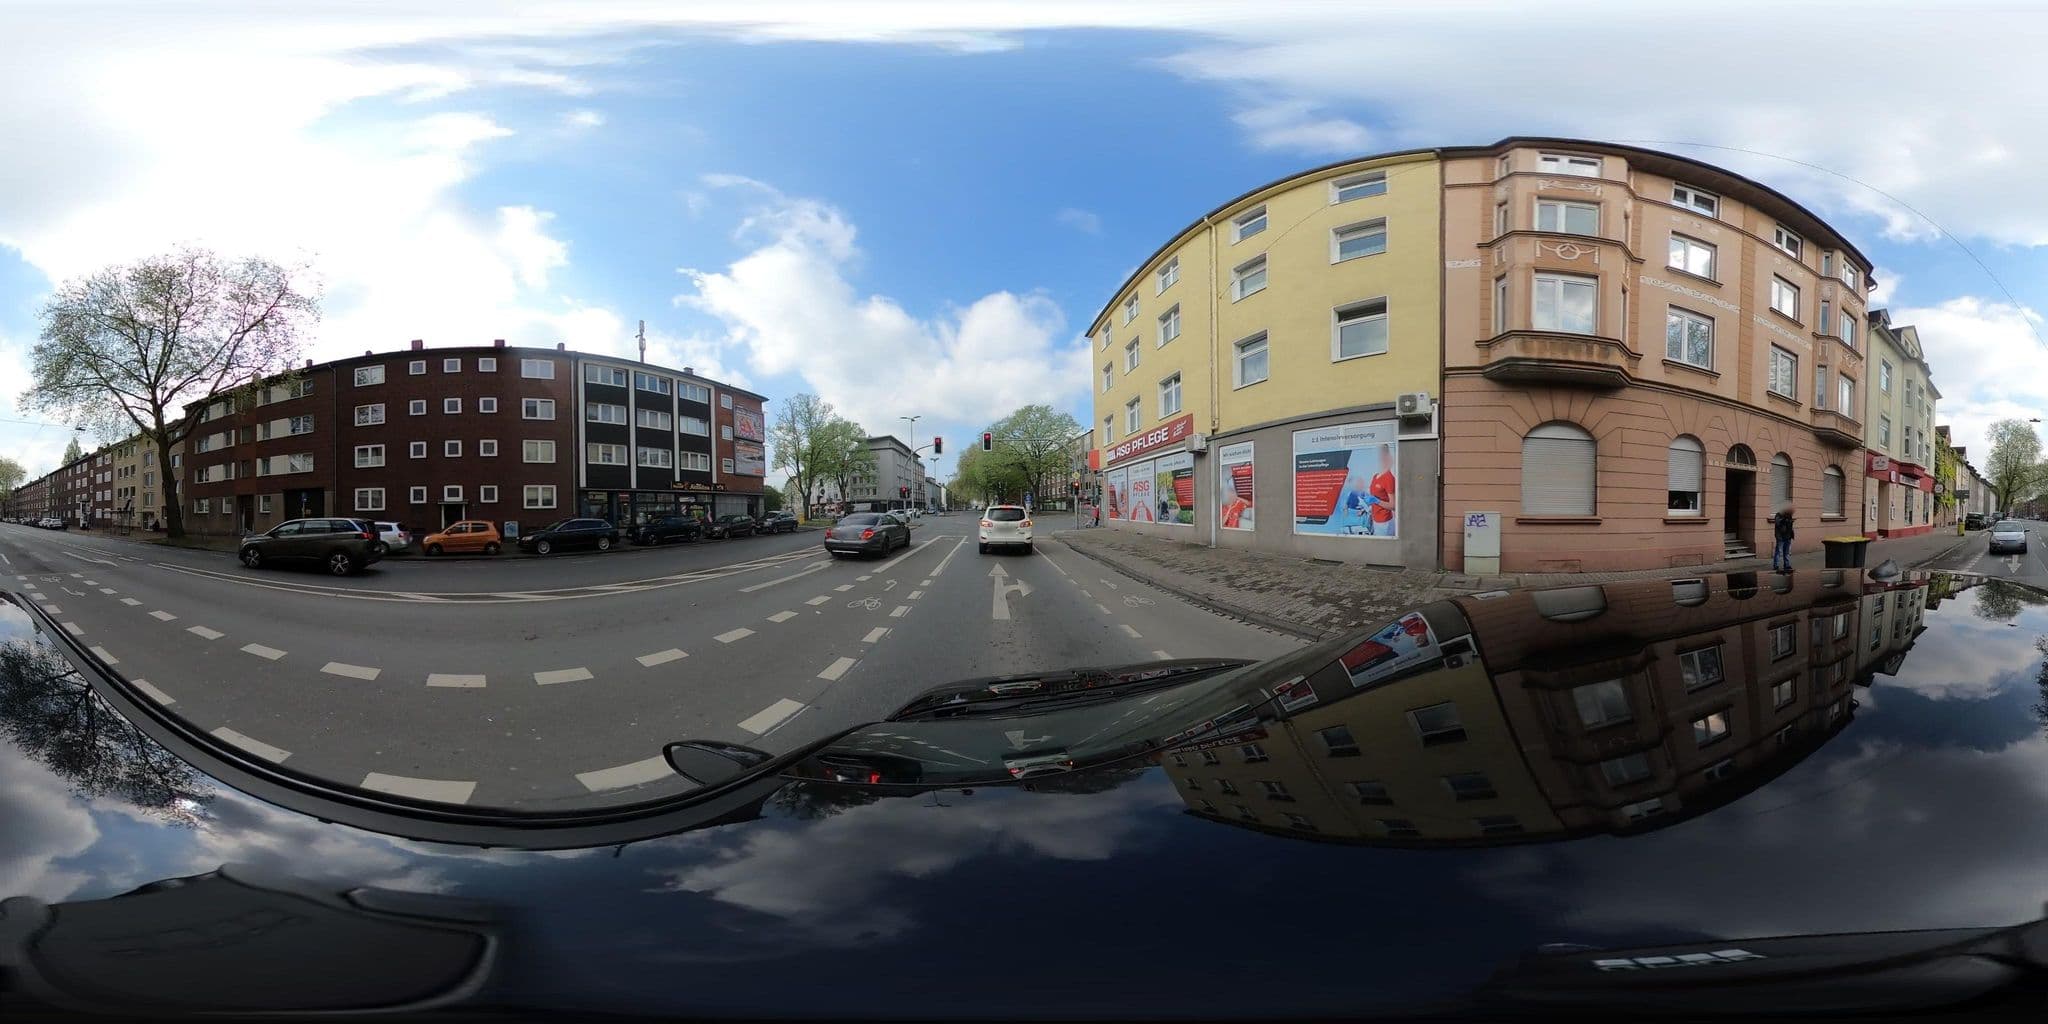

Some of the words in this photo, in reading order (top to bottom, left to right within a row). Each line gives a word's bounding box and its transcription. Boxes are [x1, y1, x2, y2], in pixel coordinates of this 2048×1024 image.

[1116, 443, 1131, 458] ASG
[1132, 427, 1169, 452] PFLEGE
[1133, 480, 1150, 492] ASG
